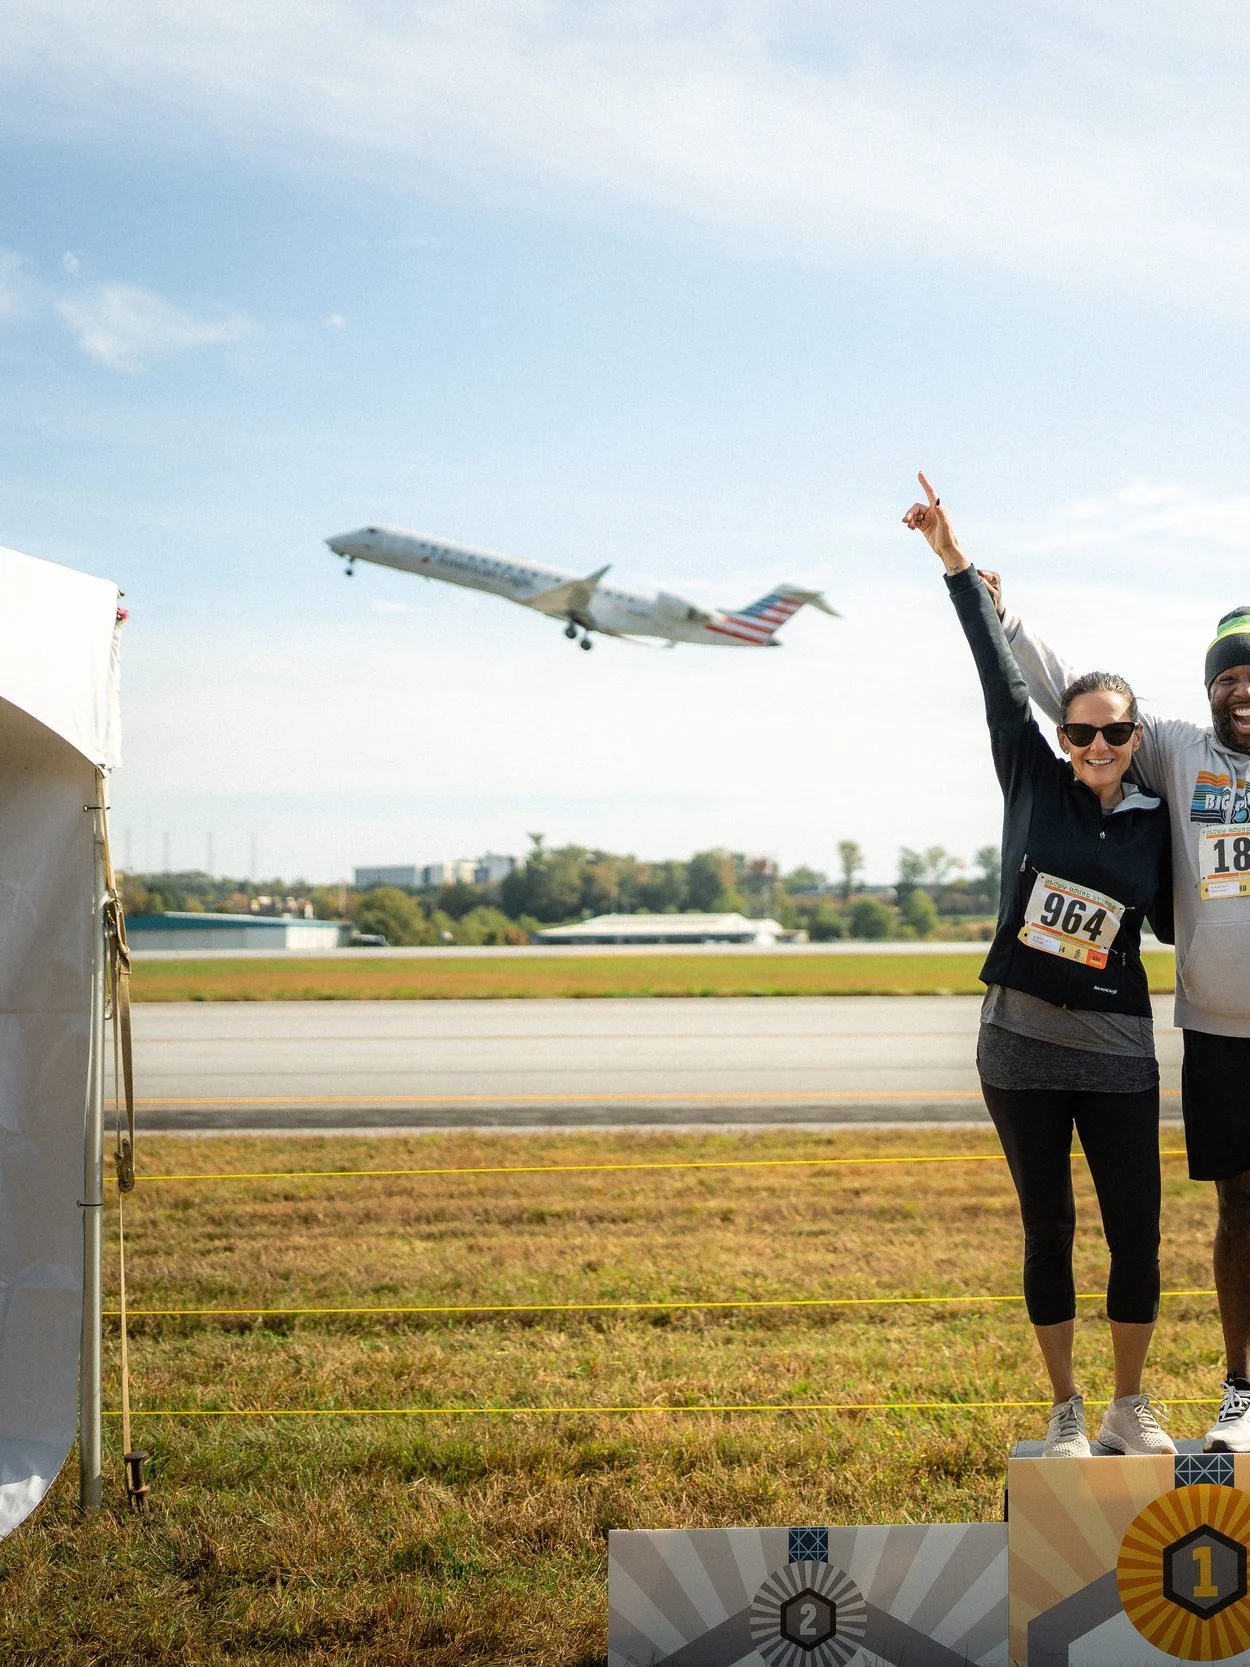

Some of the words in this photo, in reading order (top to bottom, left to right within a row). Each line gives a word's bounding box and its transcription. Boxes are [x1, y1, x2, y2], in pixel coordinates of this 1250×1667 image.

[1205, 794, 1230, 810] BIG
[1041, 892, 1107, 942] 964
[1192, 1546, 1219, 1597] 1
[800, 1603, 817, 1636] 2
